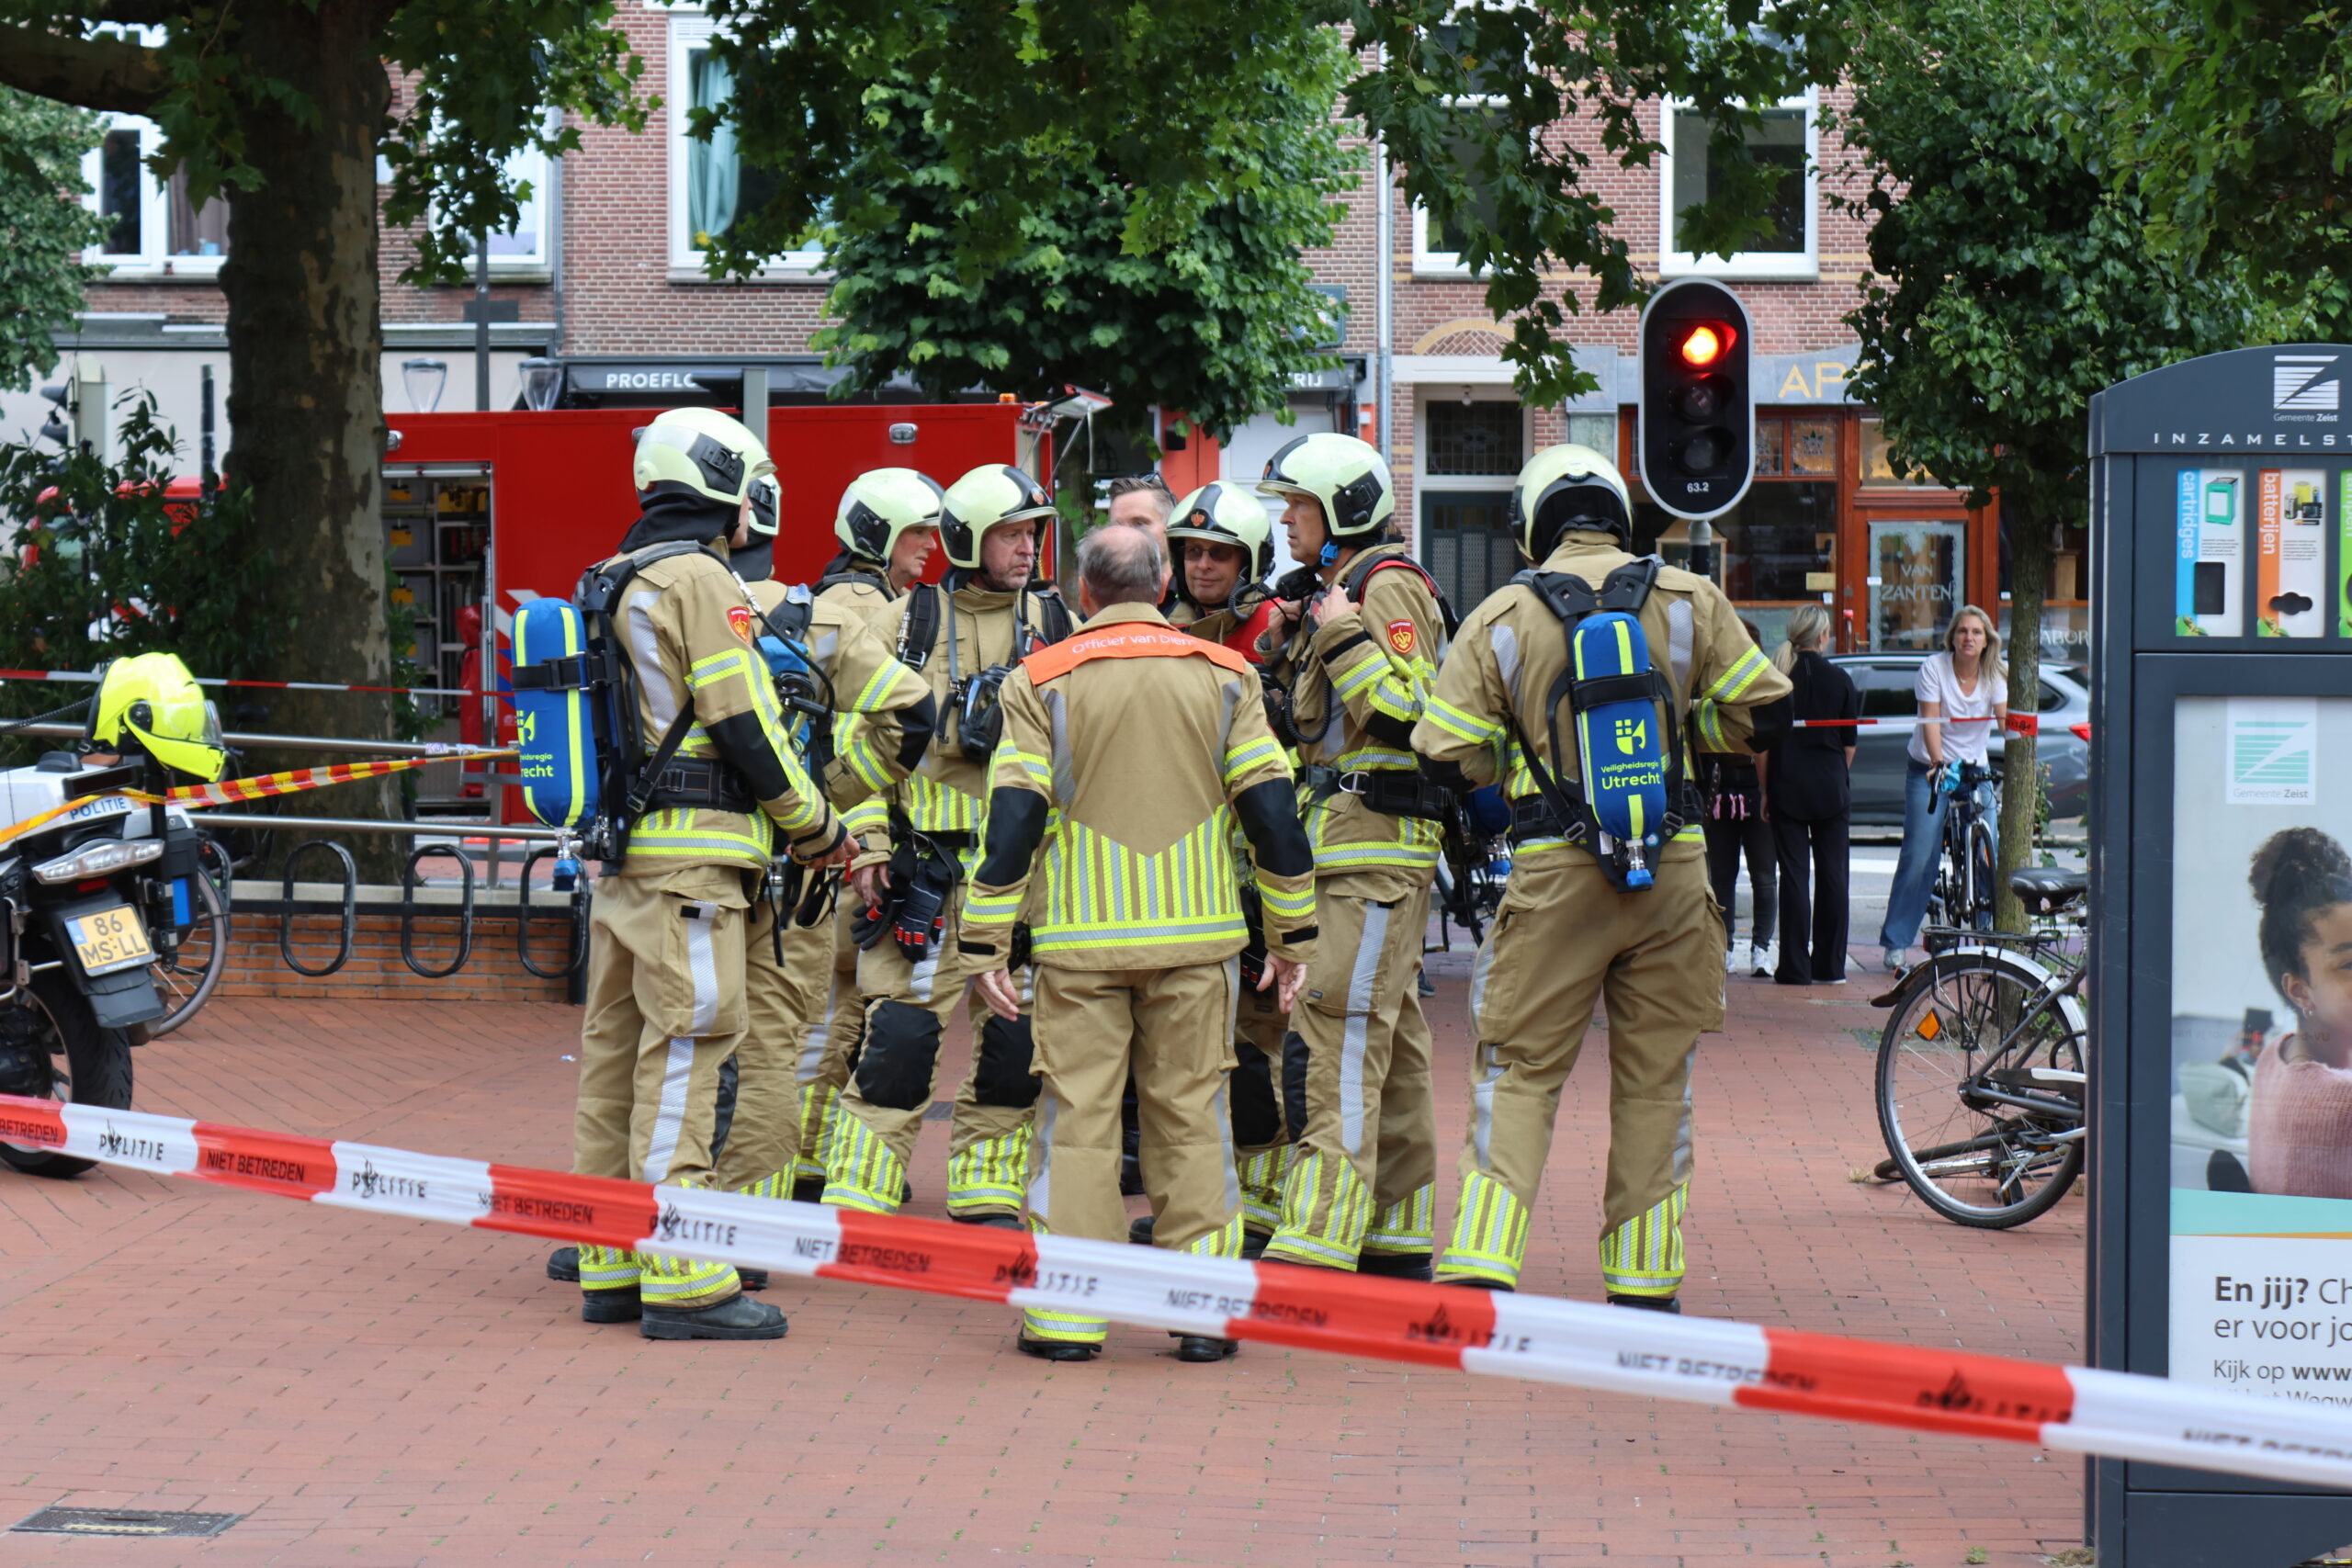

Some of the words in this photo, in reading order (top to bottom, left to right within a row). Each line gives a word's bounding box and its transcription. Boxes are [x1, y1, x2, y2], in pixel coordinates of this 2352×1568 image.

[2274, 413, 2315, 423] Gemeente
[2316, 413, 2338, 423] Zeist
[1687, 481, 1710, 493] 63.2
[2178, 471, 2199, 558] cartridges
[2260, 472, 2280, 555] batterijen
[1900, 564, 1933, 578] VAN
[1881, 581, 1951, 603] ZANTEN
[1071, 636, 1125, 654] Officier
[1128, 634, 1157, 645] van
[1601, 772, 1661, 790] Utrecht
[2284, 788, 2309, 798] Zeist
[69, 797, 127, 820] POLITIE
[94, 913, 123, 937] 86
[207, 1148, 234, 1172] NIET
[237, 1154, 305, 1183] BETREDEN
[514, 1196, 594, 1224] BETREDEN
[794, 1235, 833, 1259] NIET
[836, 1241, 931, 1274] BETREDEN
[2214, 1276, 2253, 1303] En
[2260, 1276, 2310, 1311] jij?
[2214, 1319, 2244, 1338] er
[2252, 1320, 2322, 1340] voor
[2326, 1315, 2352, 1348] jo
[2213, 1359, 2251, 1383] Kijk
[2256, 1365, 2285, 1384] op
[2291, 1366, 2352, 1381] www
